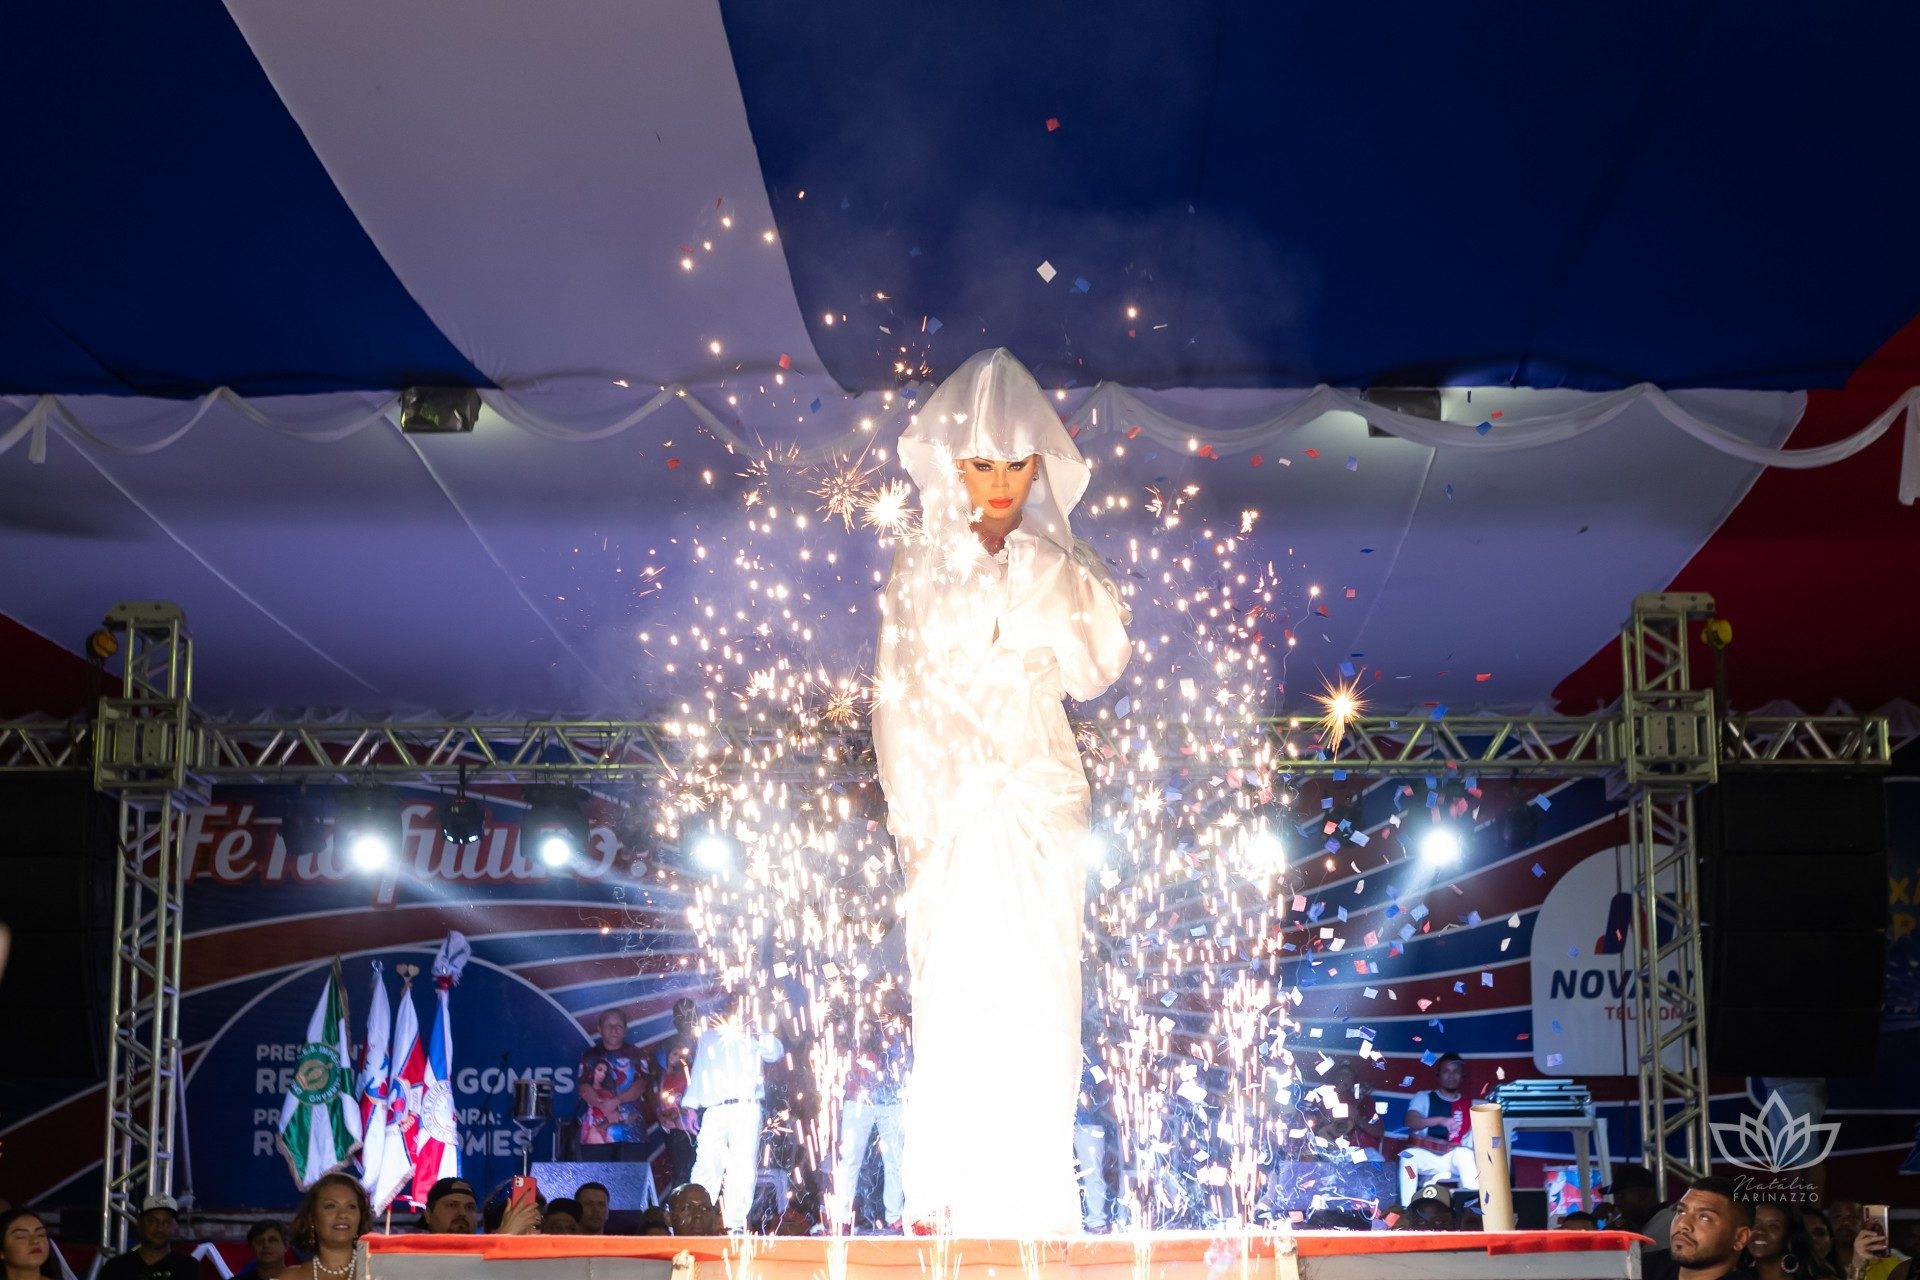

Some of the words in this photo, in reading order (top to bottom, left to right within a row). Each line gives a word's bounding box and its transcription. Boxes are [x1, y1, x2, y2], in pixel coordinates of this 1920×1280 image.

[182, 804, 257, 880] Fé
[376, 804, 649, 904] futuo
[1605, 1007, 1682, 1020] TELOM
